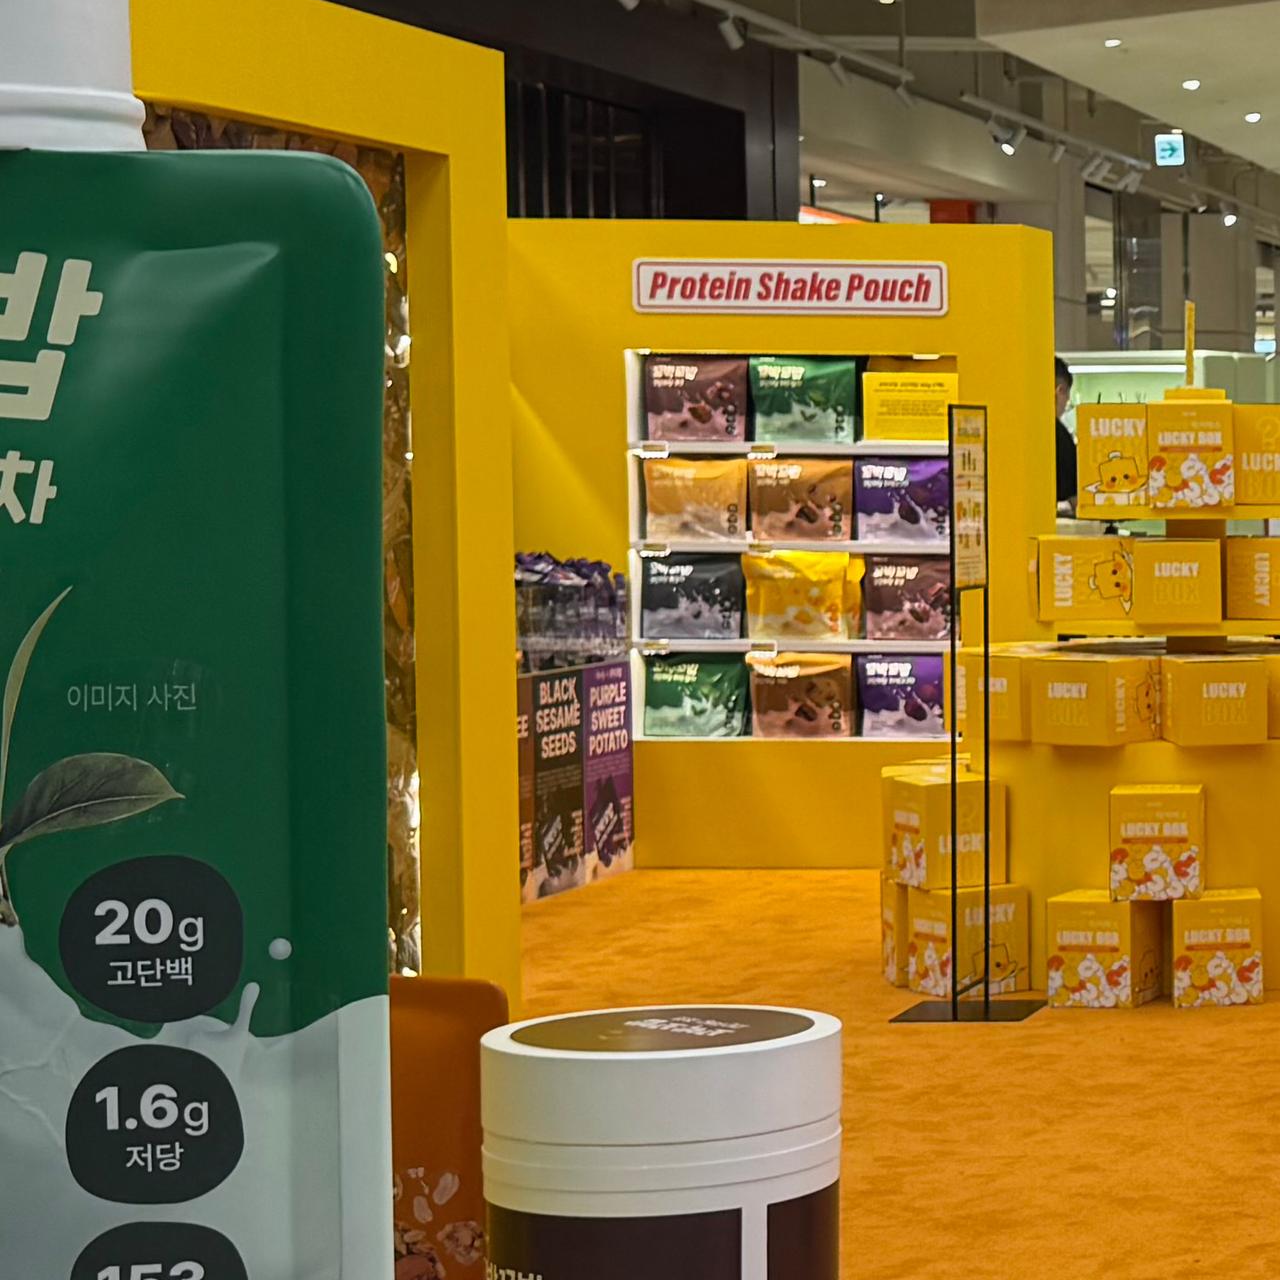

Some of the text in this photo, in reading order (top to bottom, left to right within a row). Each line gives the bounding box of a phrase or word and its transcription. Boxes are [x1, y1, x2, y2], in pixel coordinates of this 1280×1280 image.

[649, 272, 933, 304] Protein Shake Pouch
[1089, 417, 1146, 438] LUCKY
[1158, 431, 1195, 447] LUCKY
[1055, 552, 1074, 608] LUCKY
[1153, 561, 1199, 578] LUCKY
[1254, 552, 1271, 607] LUCKY
[67, 682, 198, 712] 이미지 사진
[539, 677, 578, 706] BLACK
[589, 681, 628, 708] PURPLE
[1047, 681, 1088, 699] LUCKY
[1202, 681, 1247, 699] LUCKY
[535, 701, 581, 734] SESAME
[591, 705, 626, 731] SWEET
[541, 730, 577, 759] SEEDS
[588, 728, 629, 757] POTATO
[1120, 822, 1160, 838] LUCKY
[93, 898, 205, 951] 20g
[106, 956, 195, 989] 고단백
[94, 1084, 211, 1136] 1.6g
[125, 1141, 185, 1173] 저당
